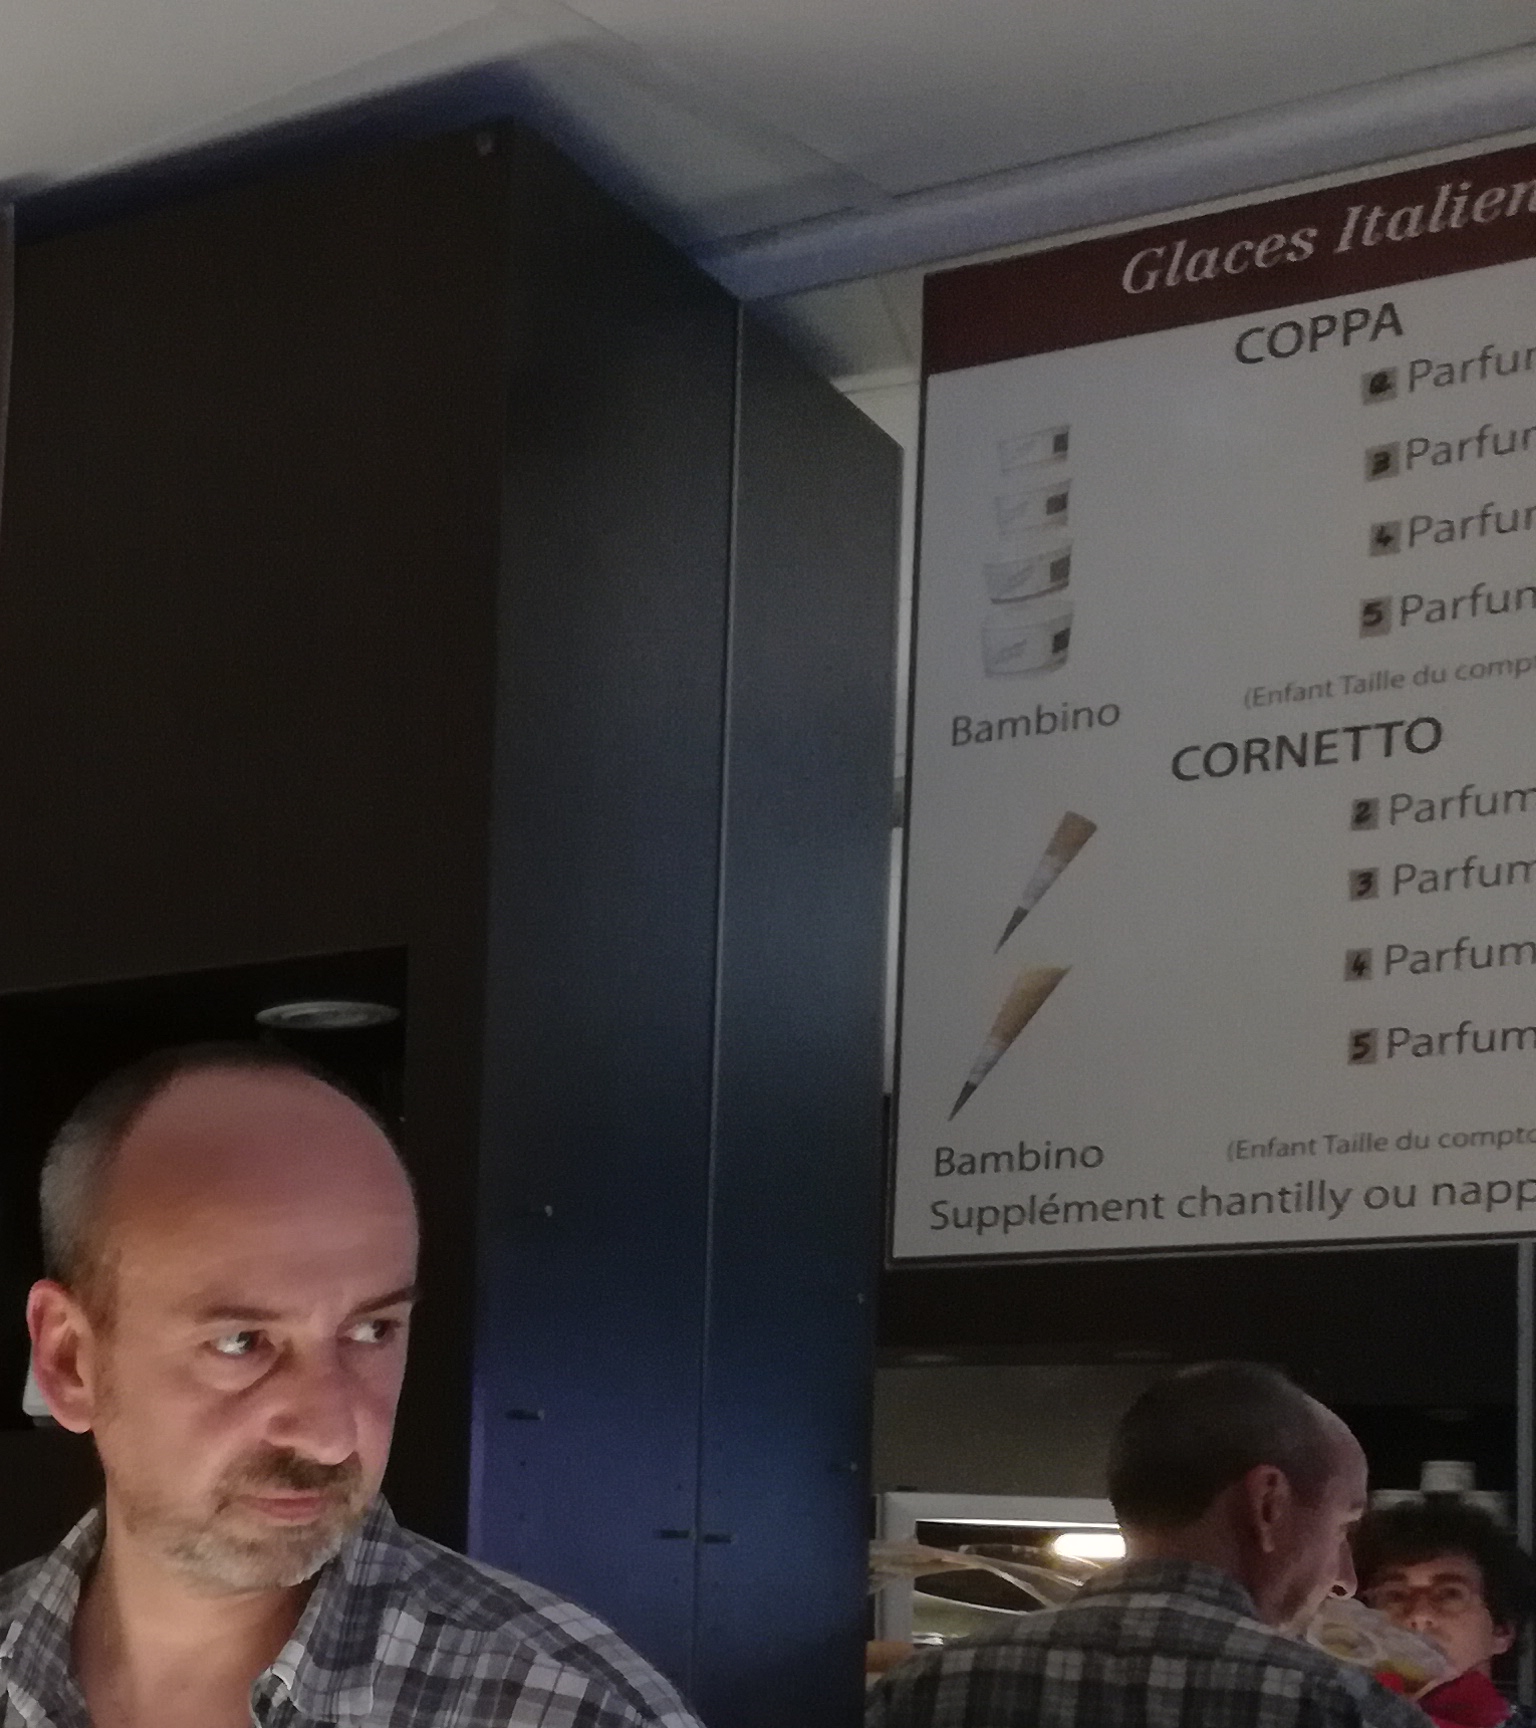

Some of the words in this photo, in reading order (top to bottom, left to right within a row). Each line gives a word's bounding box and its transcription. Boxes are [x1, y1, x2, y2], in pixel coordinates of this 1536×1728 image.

[1121, 227, 1318, 294] Glaces
[1333, 179, 1536, 254] Italien
[1235, 302, 1404, 364] COPPA
[1409, 344, 1536, 392] Parfu
[1409, 501, 1536, 547] Parfu
[1244, 680, 1333, 710] (Enfant
[1339, 669, 1405, 696] Taille
[1413, 664, 1447, 687] du
[1454, 654, 1536, 682] comp
[951, 702, 1120, 746] Bambino
[1171, 717, 1442, 781] CORNETTO
[1385, 937, 1536, 975] Parfum
[1351, 1031, 1371, 1062] 5
[1387, 1020, 1536, 1059] Parfum
[934, 1141, 1104, 1177] Bambino
[1228, 1136, 1317, 1162] (Enfant
[1323, 1132, 1389, 1155] Taille
[1395, 1129, 1429, 1151] du
[930, 1193, 1165, 1235] Supplément
[1178, 1180, 1353, 1221] chantilly
[1363, 1184, 1417, 1210] ou
[1432, 1178, 1536, 1213] napp
